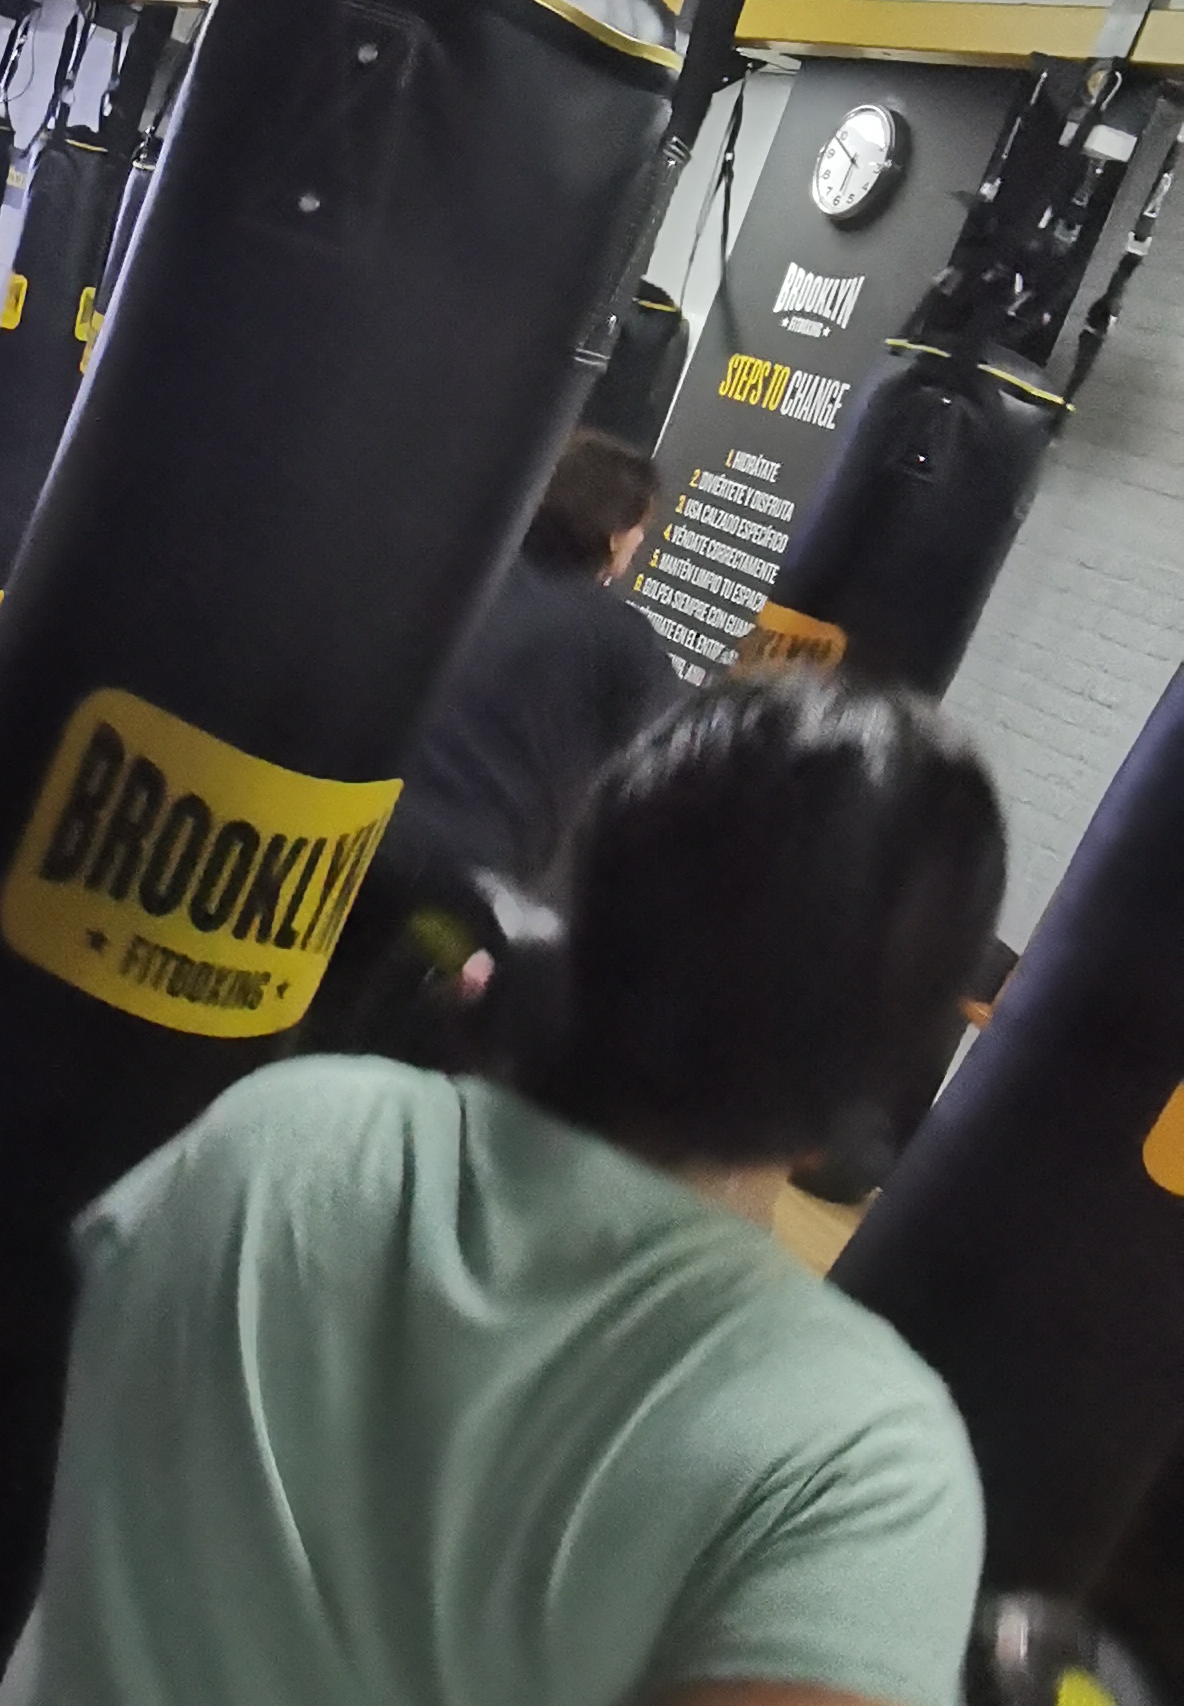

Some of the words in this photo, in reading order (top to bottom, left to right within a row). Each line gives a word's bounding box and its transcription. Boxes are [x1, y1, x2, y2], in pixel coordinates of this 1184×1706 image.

[773, 262, 866, 330] BROOKLYN
[718, 353, 772, 405] STEPS
[761, 363, 791, 411] TO
[779, 370, 851, 430] CHANGE
